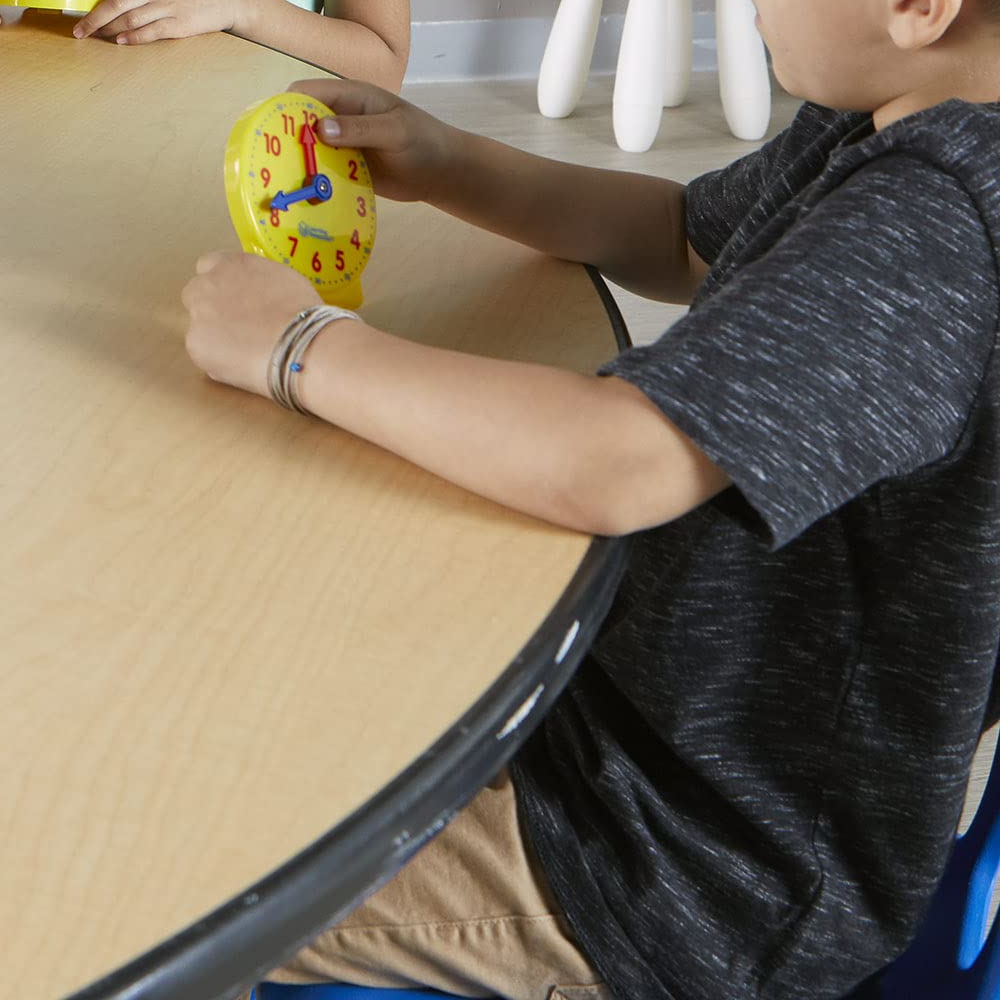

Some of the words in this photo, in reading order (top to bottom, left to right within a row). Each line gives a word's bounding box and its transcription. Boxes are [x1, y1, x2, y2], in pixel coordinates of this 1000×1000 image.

[281, 113, 295, 137] 11
[263, 132, 282, 157] 10
[261, 167, 271, 187] 9
[348, 159, 358, 181] 2
[270, 208, 280, 227] 8
[357, 197, 366, 217] 3
[288, 236, 299, 257] 7
[350, 229, 362, 250] 4
[311, 252, 322, 273] 6
[335, 250, 345, 271] 5
